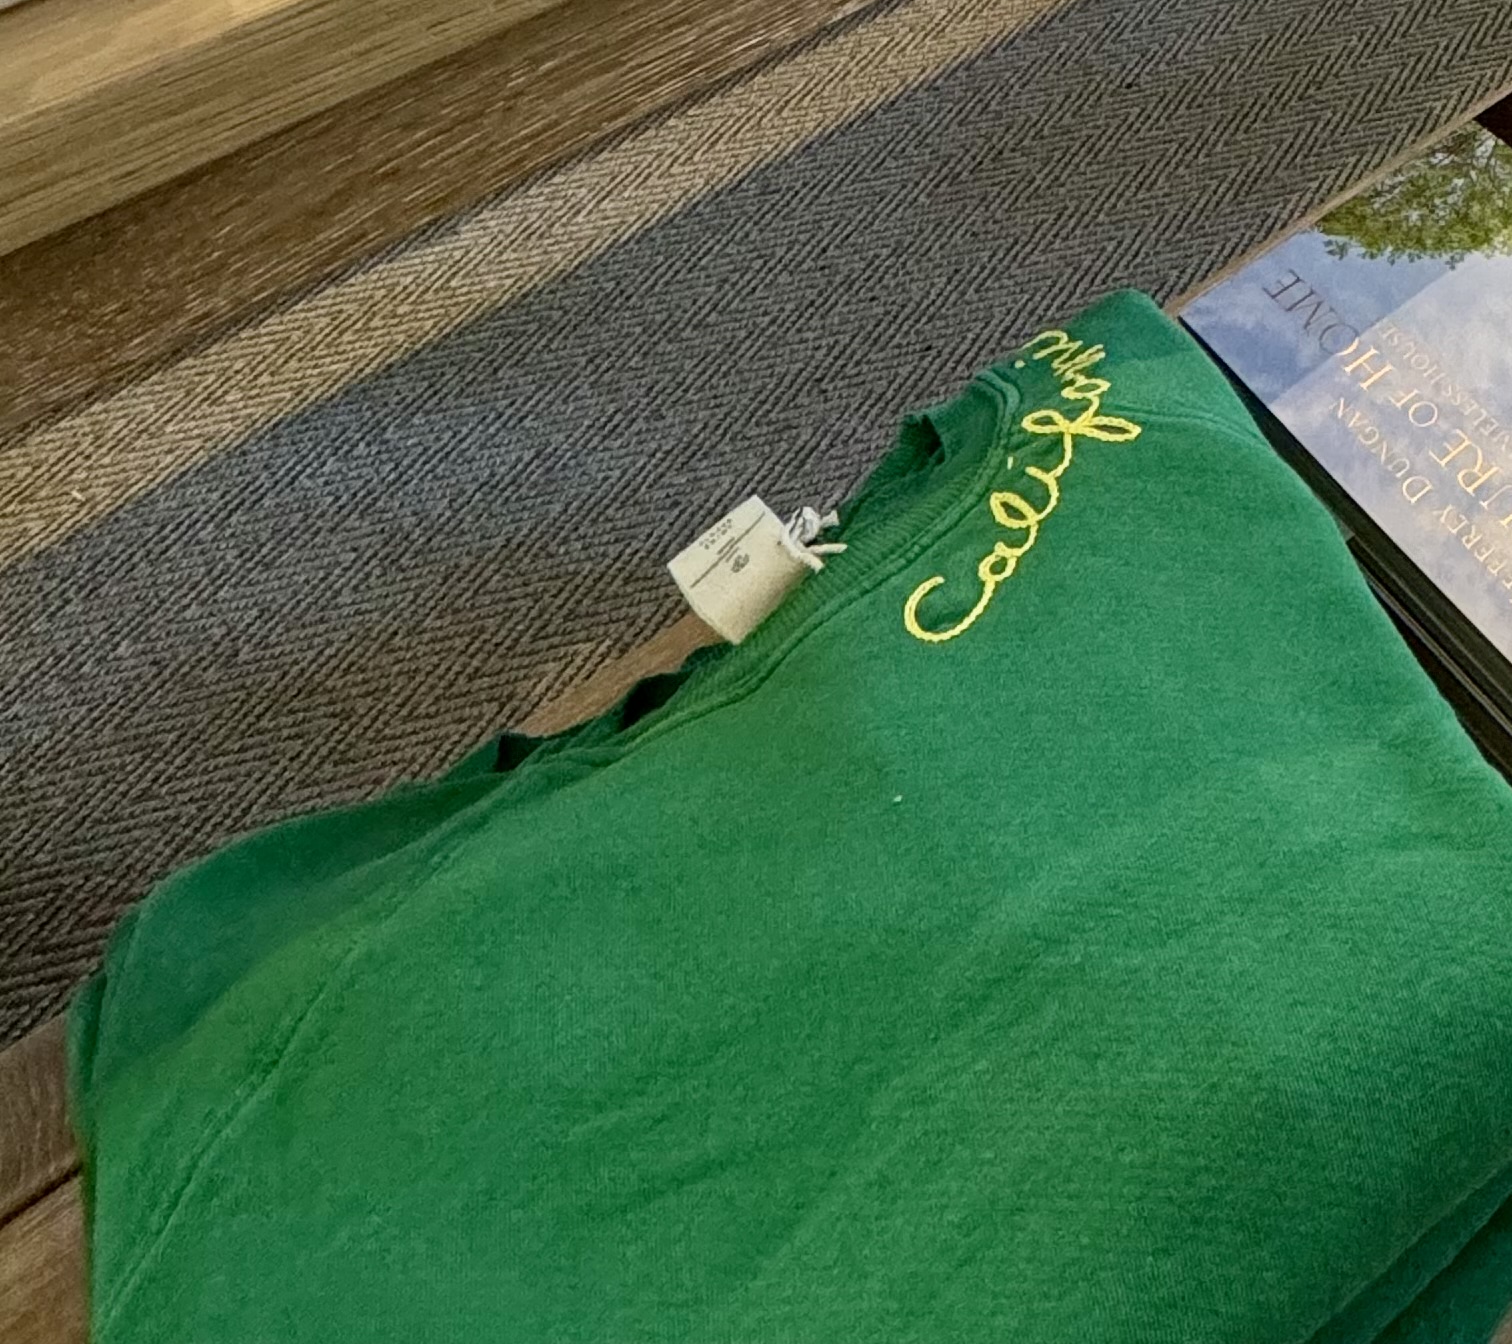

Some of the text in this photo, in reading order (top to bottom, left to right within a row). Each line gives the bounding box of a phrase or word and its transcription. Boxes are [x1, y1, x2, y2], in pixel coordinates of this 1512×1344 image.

[1261, 268, 1395, 393] HOME
[1331, 396, 1434, 506] DUNGAN
[1391, 388, 1440, 429] OF
